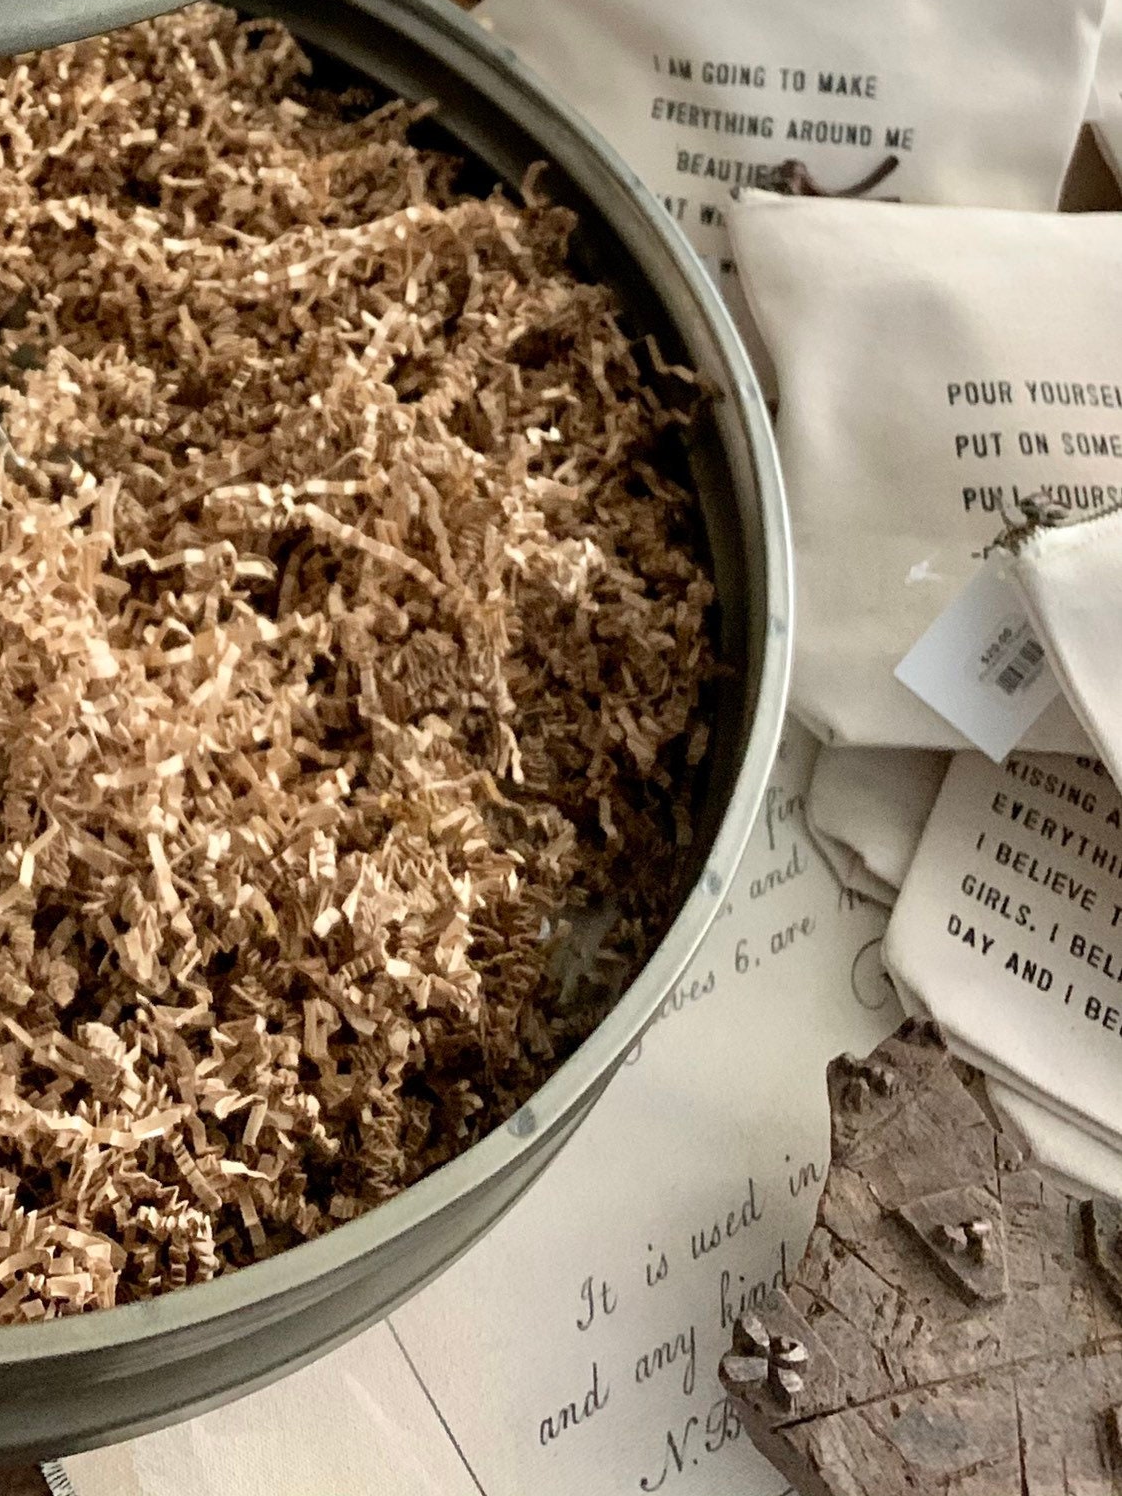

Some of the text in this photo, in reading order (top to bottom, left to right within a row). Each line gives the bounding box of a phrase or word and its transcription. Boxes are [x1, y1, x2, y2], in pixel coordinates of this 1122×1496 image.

[653, 54, 879, 99] I AM GOING TO MAKE
[650, 97, 916, 151] EVERYTHING AROUND ME
[946, 379, 1013, 406] POUR
[954, 431, 1122, 459] PUT ON SOME
[1039, 482, 1122, 511] YOURS
[1005, 757, 1098, 814] KISSING
[749, 841, 807, 900] and
[975, 831, 985, 852] I
[994, 841, 1098, 913] BELIEVE
[770, 915, 816, 955] are
[960, 873, 1036, 932] GIRLS.
[1049, 922, 1060, 943] I
[946, 913, 1122, 1038] DAY AND I BE
[576, 1275, 619, 1332] It
[645, 1242, 669, 1287] is
[690, 1176, 766, 1260] used
[539, 1360, 611, 1447] and
[634, 1325, 697, 1396] any
